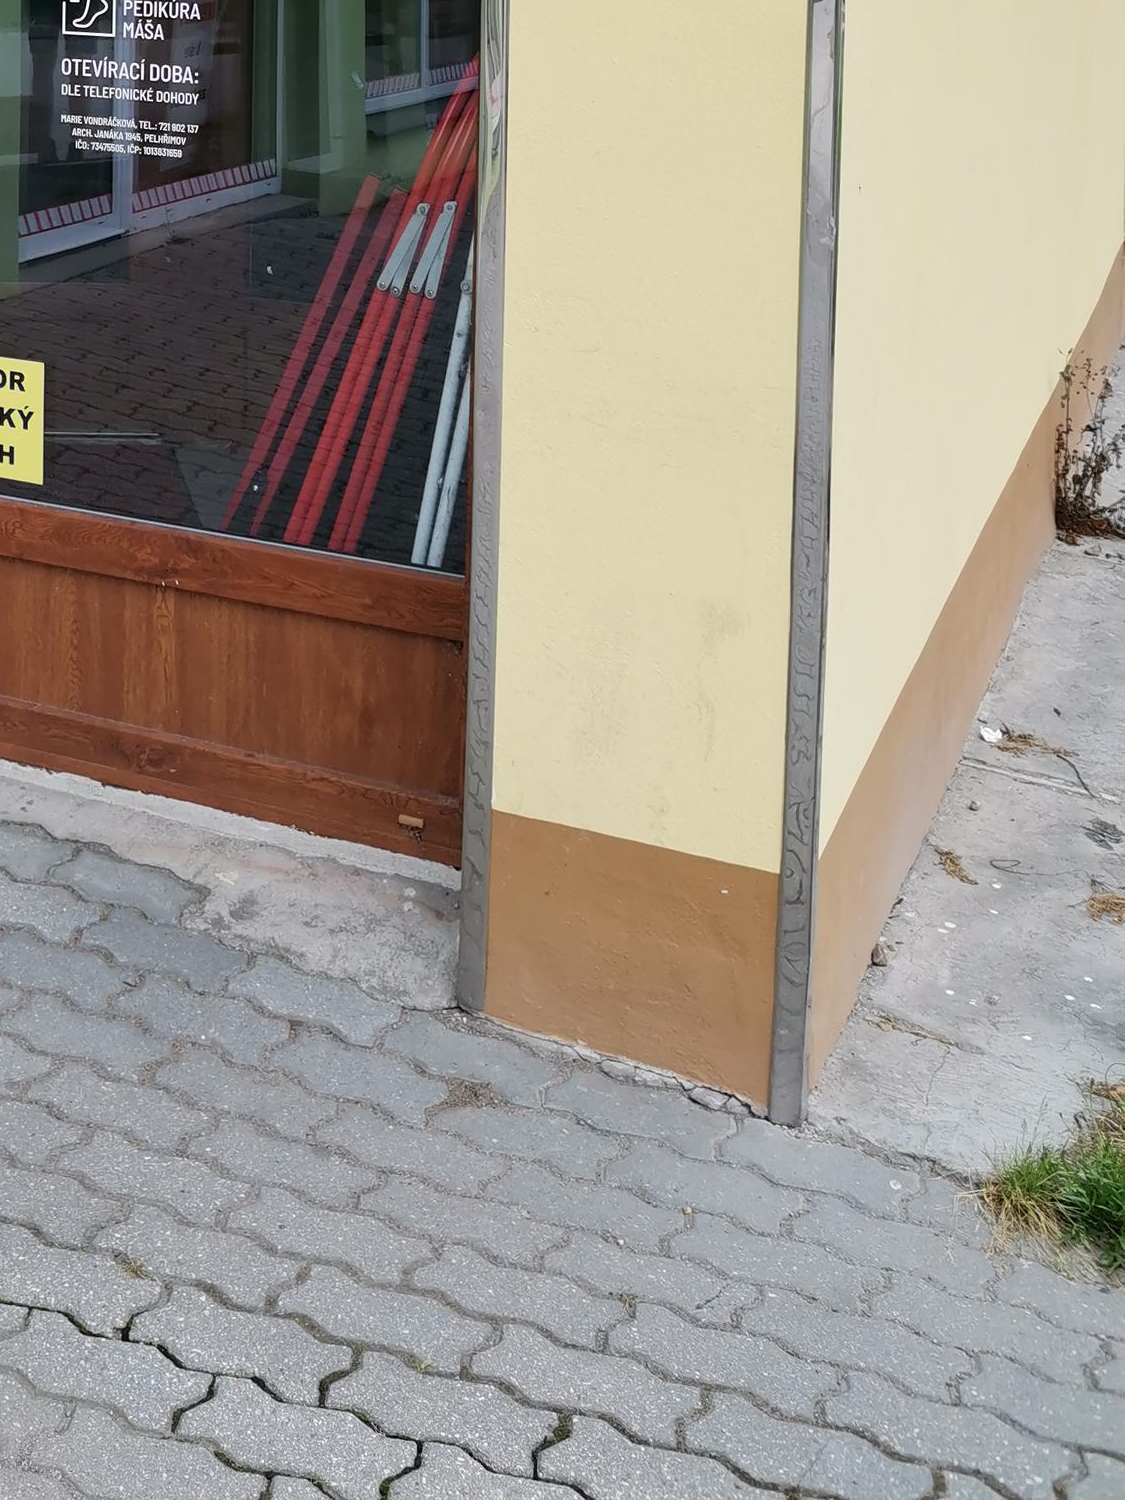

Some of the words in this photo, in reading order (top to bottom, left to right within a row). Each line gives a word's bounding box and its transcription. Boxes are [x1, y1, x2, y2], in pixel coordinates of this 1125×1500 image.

[123, 20, 165, 41] MÁŠA
[61, 56, 146, 81] OTEVÍRACÍ
[149, 63, 199, 84] DOBA:
[61, 83, 81, 97] DLE
[83, 85, 154, 102] TELEFONICKÉ
[156, 90, 199, 105] DOHODY
[60, 114, 82, 125] MARIE
[83, 115, 138, 129] VONDRÁČKOVÁ,
[139, 120, 157, 130] TEL.:
[159, 122, 171, 131] 721
[187, 124, 199, 134] 137
[72, 128, 93, 137] ARCH.
[94, 128, 123, 141] JANÁKA
[125, 132, 143, 142] 1945,
[144, 133, 186, 146] PELHŘIMOV
[75, 140, 90, 150] IČO:
[127, 144, 142, 155] IČP:
